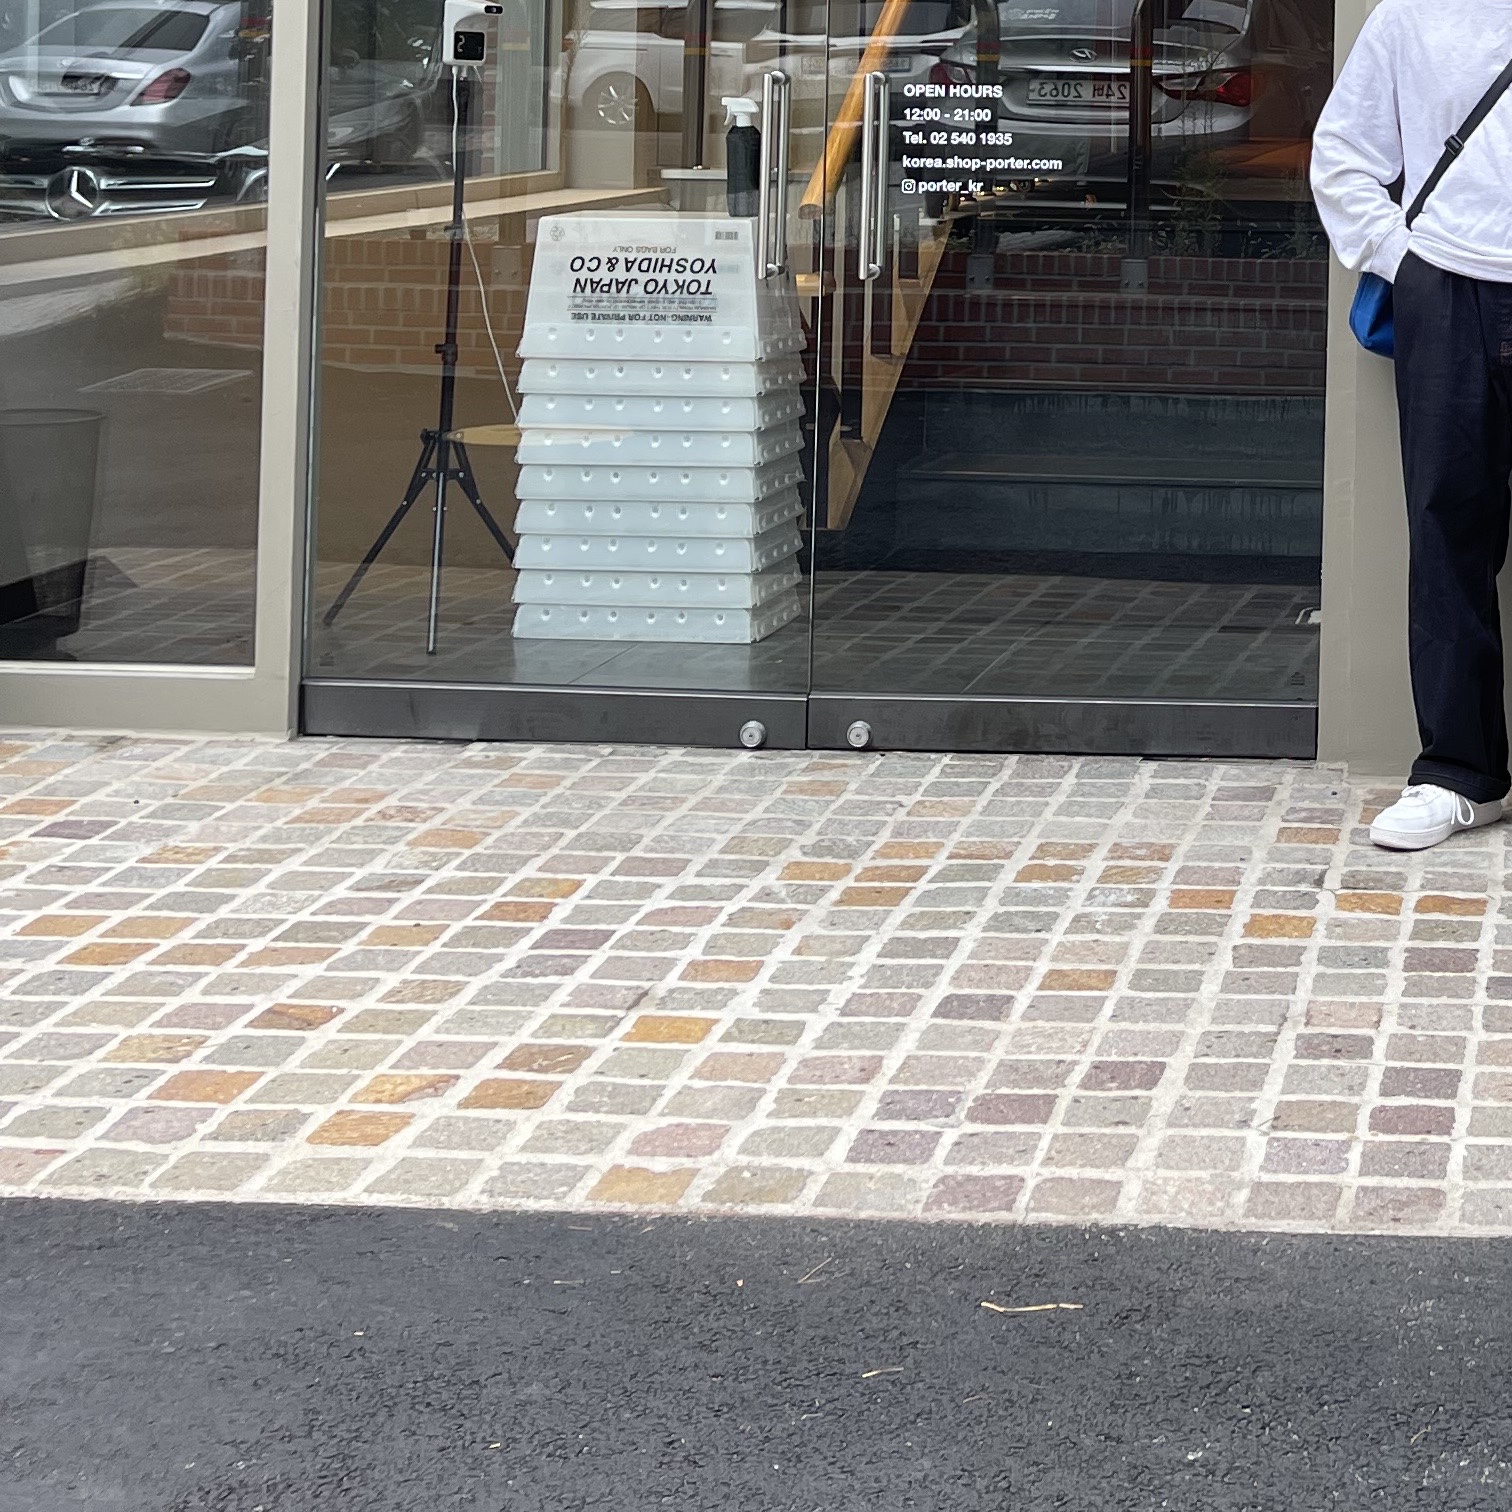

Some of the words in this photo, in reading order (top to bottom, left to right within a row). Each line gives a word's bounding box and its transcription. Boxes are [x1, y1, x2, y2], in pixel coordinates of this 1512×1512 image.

[904, 84, 945, 97] OPEN
[950, 85, 1003, 98] HOURS
[904, 108, 940, 121] 12:00
[954, 109, 991, 121] 21:00
[902, 132, 927, 144] Tel.
[930, 132, 947, 145] 02
[951, 132, 976, 145] 540
[980, 133, 1013, 145] 1935
[902, 155, 1063, 171] korea.shop-porter.com
[918, 179, 984, 194] porter_kr
[570, 256, 601, 273] CO
[606, 256, 619, 273] &
[624, 257, 717, 274] YOSHIDA
[573, 277, 638, 294] JAPAN
[643, 278, 713, 295] TOKYO
